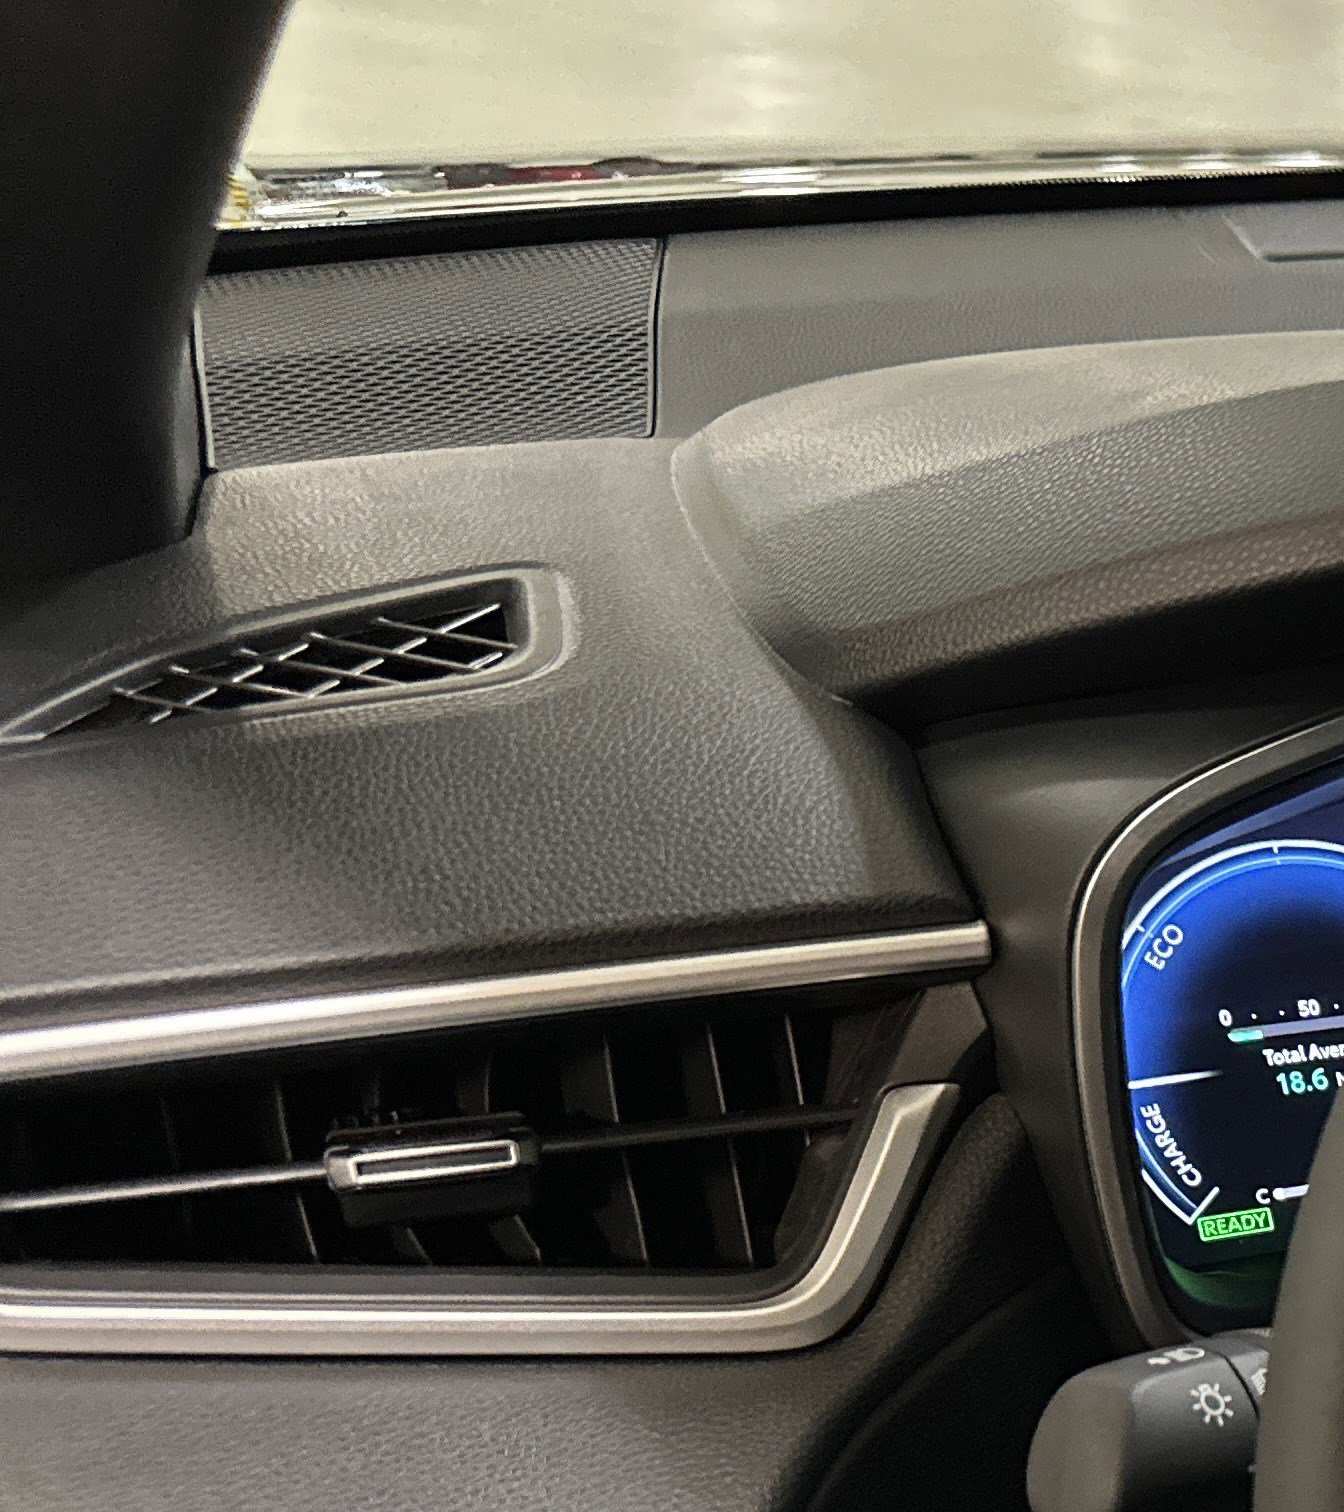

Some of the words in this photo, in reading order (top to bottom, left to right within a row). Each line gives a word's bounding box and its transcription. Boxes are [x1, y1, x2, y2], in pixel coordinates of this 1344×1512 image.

[1143, 922, 1185, 972] ECO
[1218, 1009, 1233, 1028] 0
[1297, 999, 1321, 1017] 50
[1261, 1044, 1307, 1067] Total
[1275, 1066, 1330, 1096] 18.6
[1139, 1101, 1203, 1188] CHARGE
[1255, 1188, 1272, 1205] C
[1202, 1211, 1270, 1238] READY
